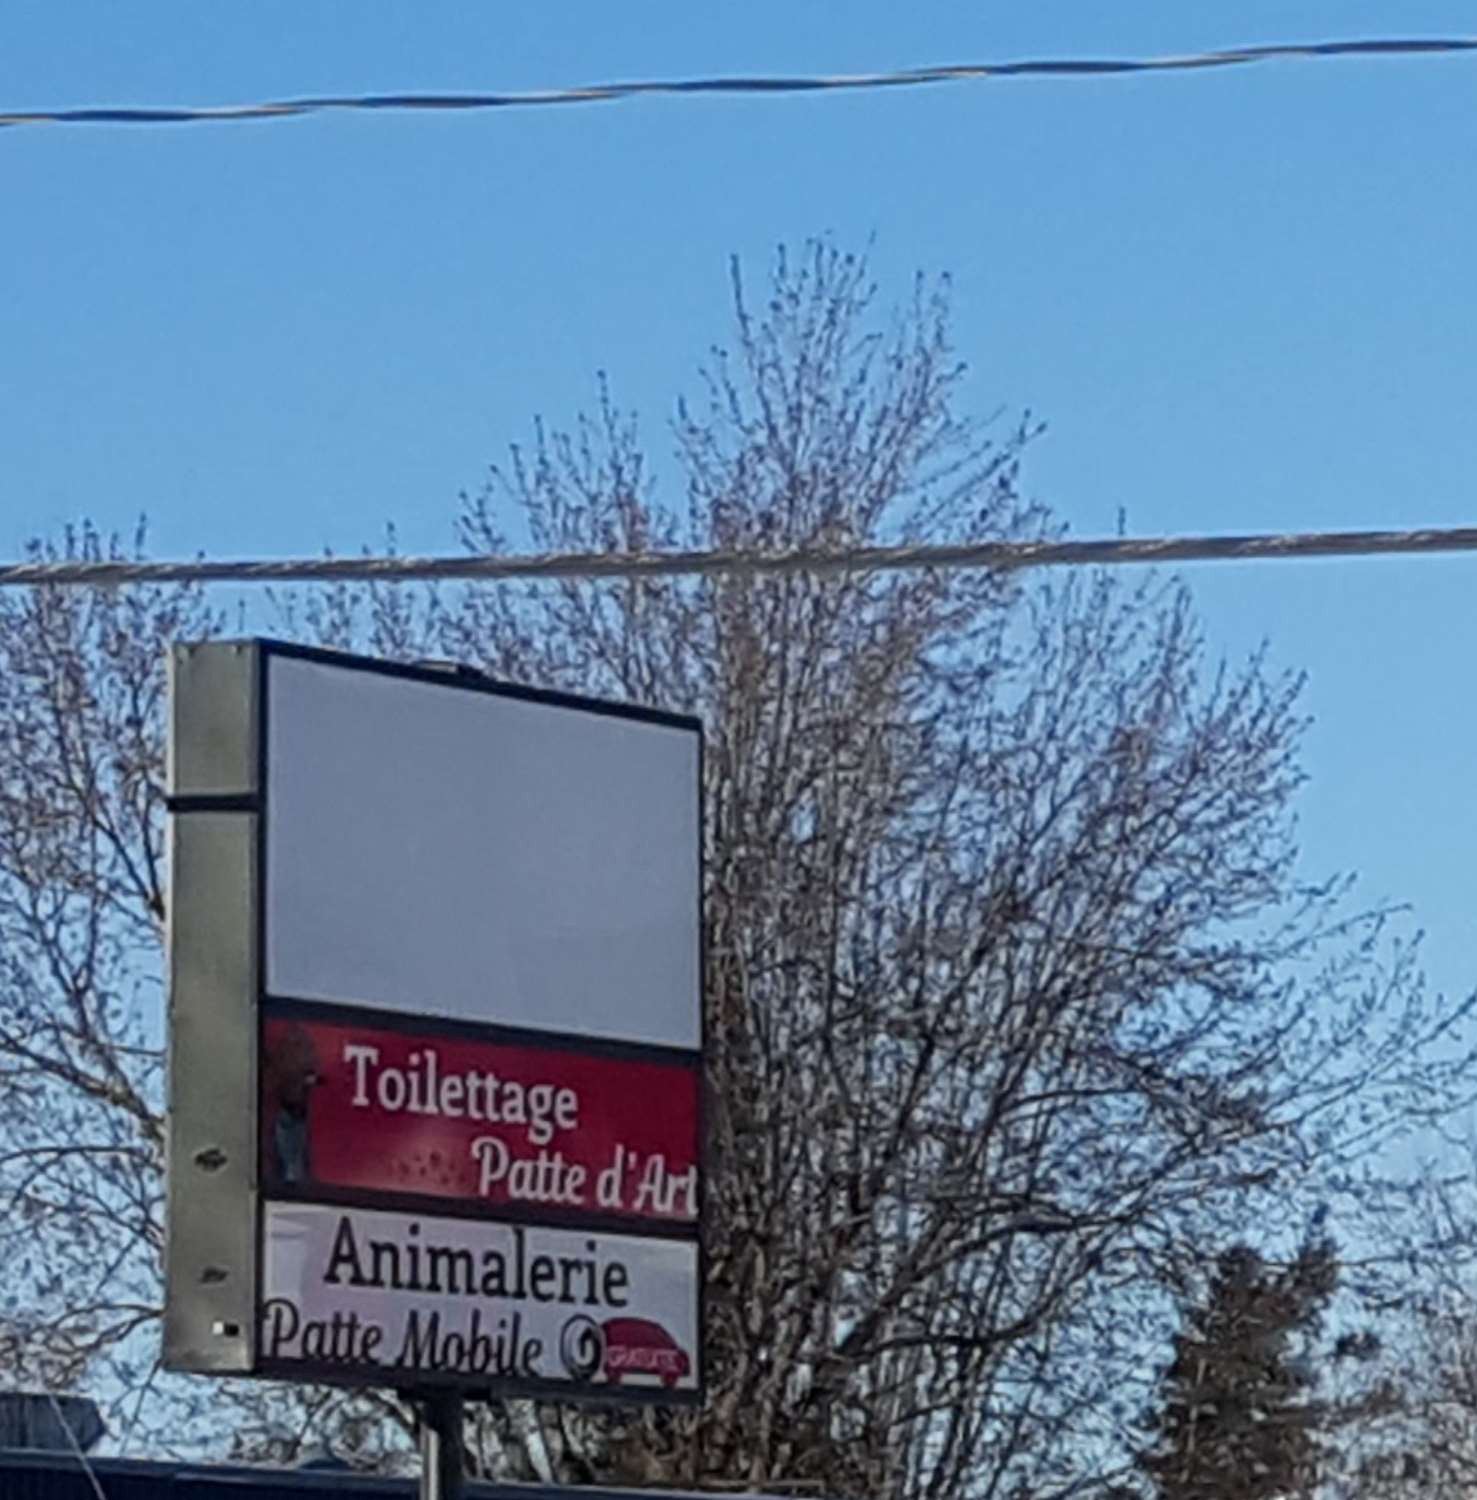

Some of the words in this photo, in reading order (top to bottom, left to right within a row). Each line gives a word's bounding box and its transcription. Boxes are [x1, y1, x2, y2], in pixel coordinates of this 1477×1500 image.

[344, 1045, 579, 1144] Toilettage
[471, 1137, 584, 1205] Patte
[595, 1143, 699, 1215] d'Art
[322, 1216, 629, 1307] Animalerie
[262, 1299, 383, 1362] Patte
[393, 1309, 543, 1378] Mobile
